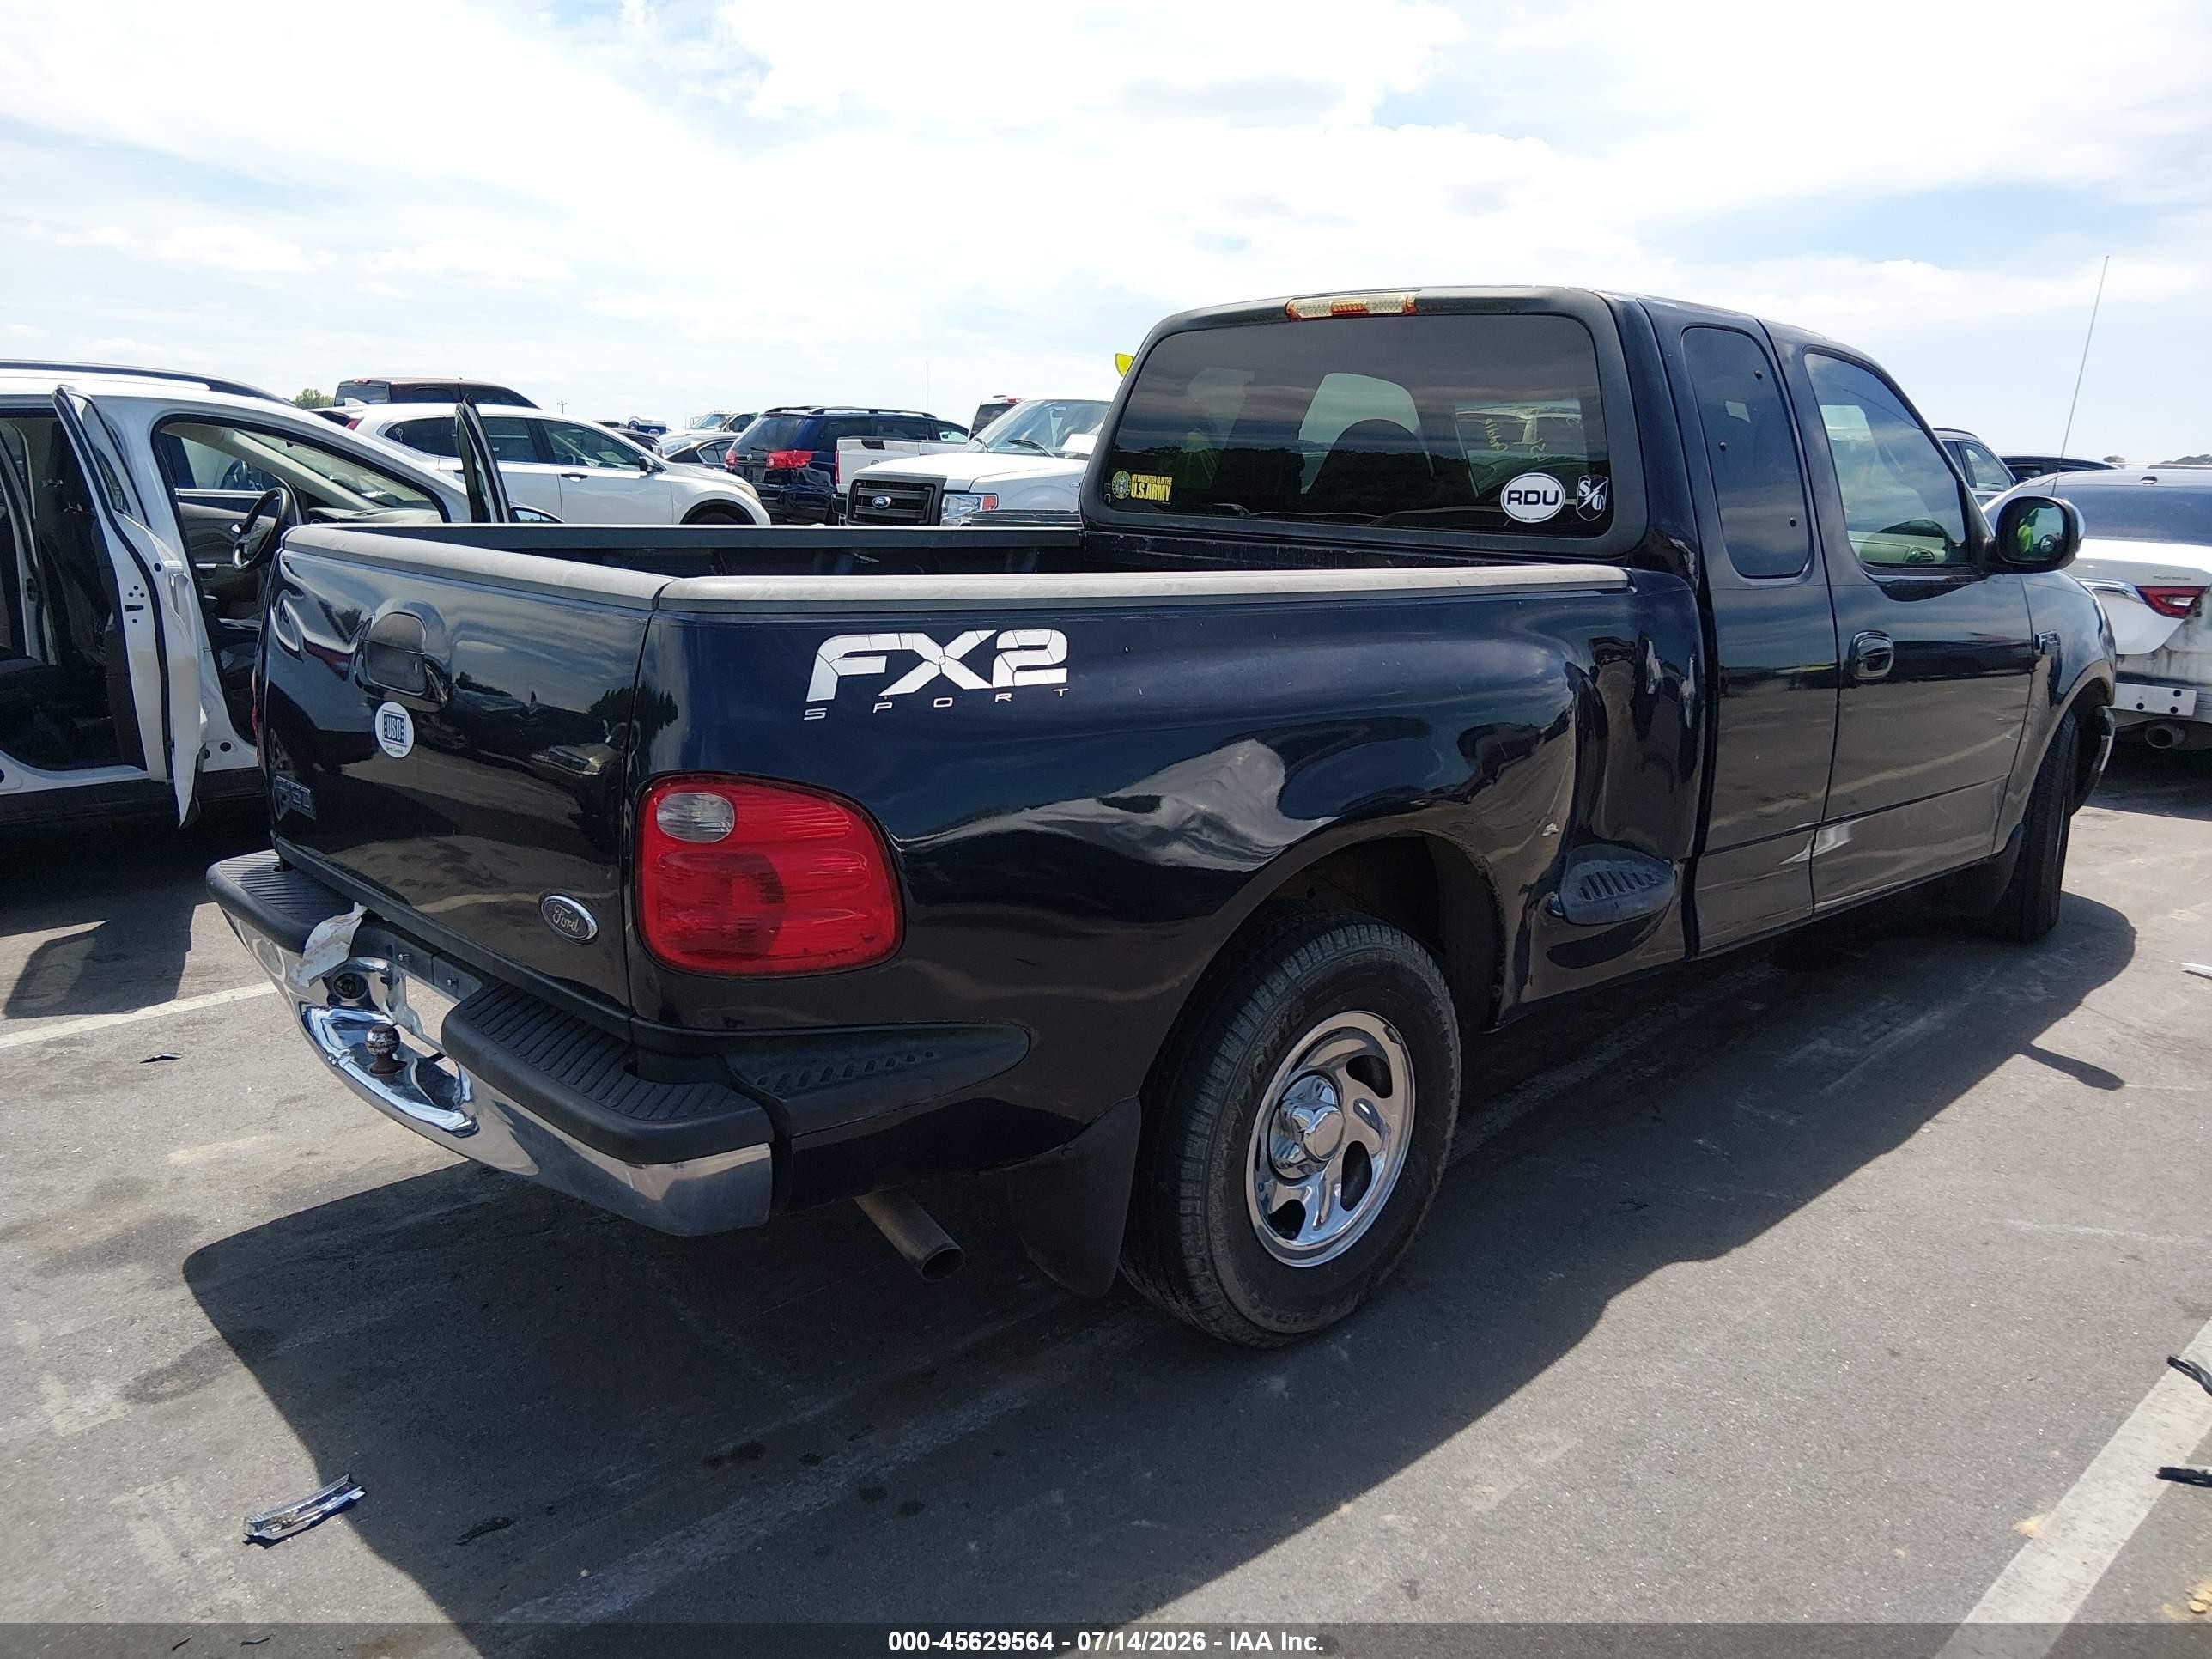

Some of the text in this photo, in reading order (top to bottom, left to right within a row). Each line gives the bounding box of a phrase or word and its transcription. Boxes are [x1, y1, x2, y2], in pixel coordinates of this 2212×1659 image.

[1507, 489, 1560, 507] RDU
[805, 629, 1068, 702] FX2
[804, 688, 1070, 720] SPORT
[386, 714, 402, 741] USO
[552, 904, 580, 933] Ford
